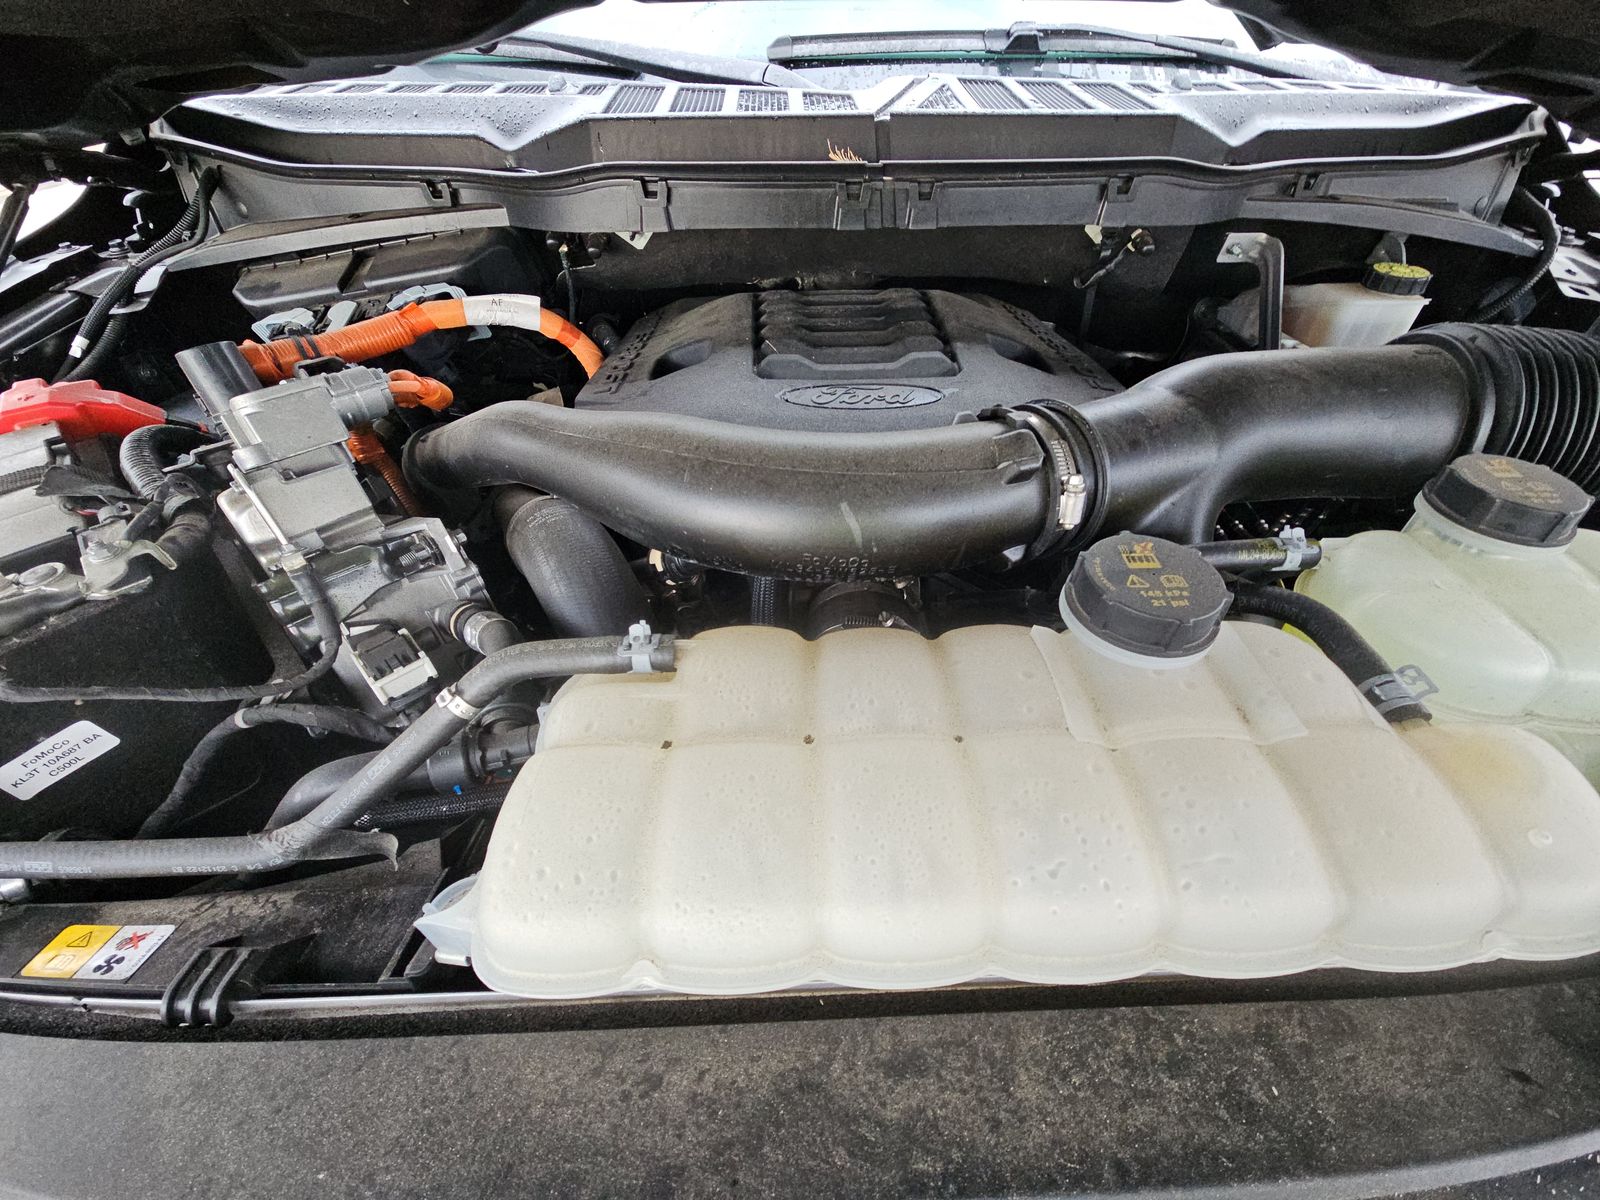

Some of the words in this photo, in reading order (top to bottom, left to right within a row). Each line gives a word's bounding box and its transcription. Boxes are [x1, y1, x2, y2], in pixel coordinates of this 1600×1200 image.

[811, 386, 916, 405] Ford
[11, 768, 40, 788] KL3T
[42, 743, 81, 768] 10A687
[83, 733, 103, 745] BA
[21, 739, 70, 768] FoMoCo
[49, 756, 85, 777] C500L
